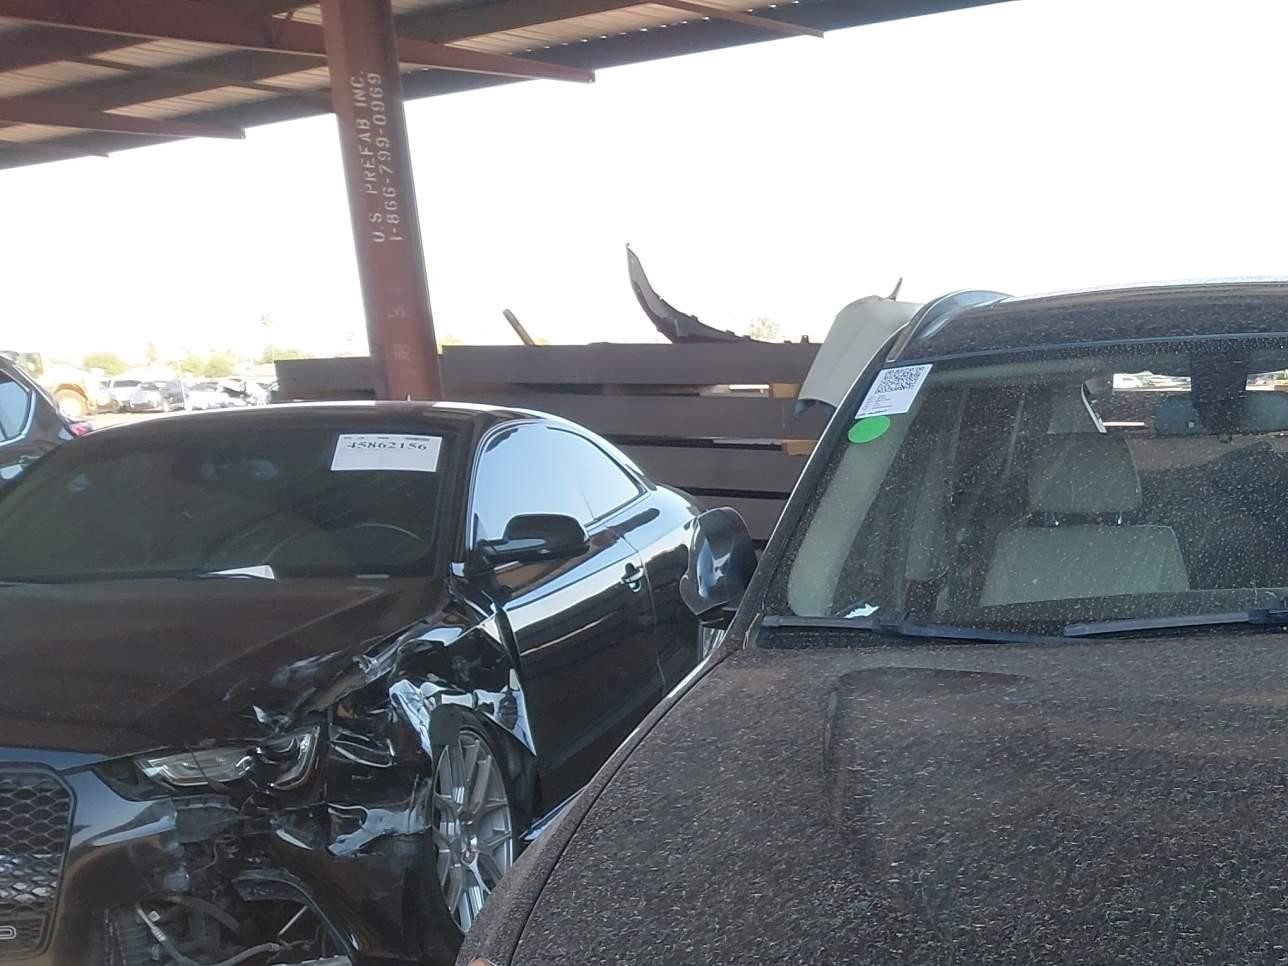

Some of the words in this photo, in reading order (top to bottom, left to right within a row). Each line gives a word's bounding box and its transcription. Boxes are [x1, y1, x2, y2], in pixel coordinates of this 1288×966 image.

[351, 71, 367, 107] INC.
[356, 119, 379, 194] PREFAB
[367, 73, 403, 241] 1-866-799-0969
[347, 441, 427, 450] 45862156
